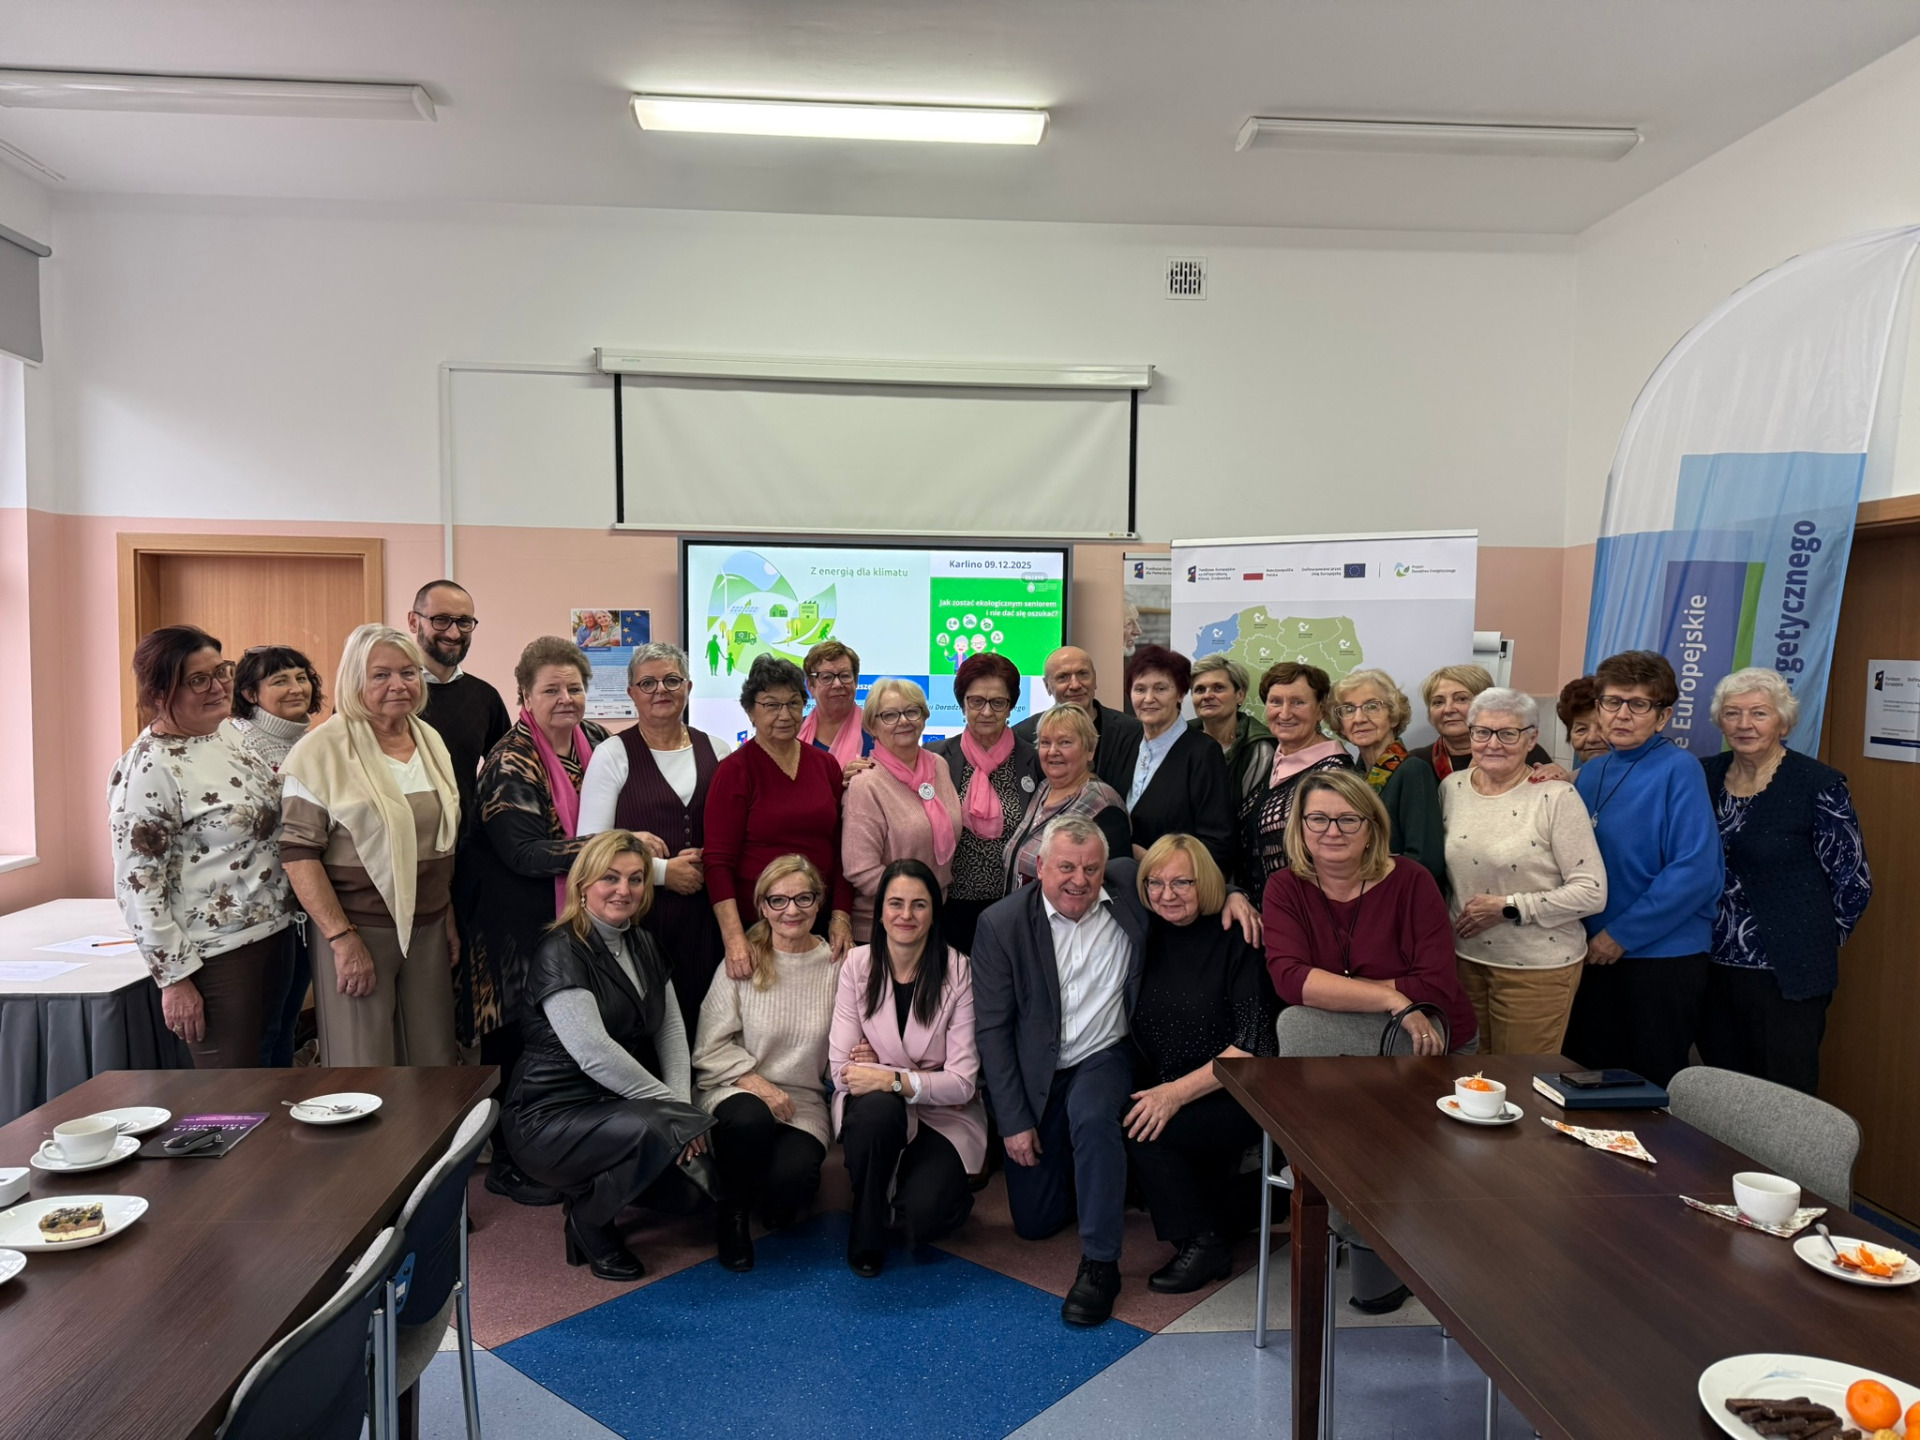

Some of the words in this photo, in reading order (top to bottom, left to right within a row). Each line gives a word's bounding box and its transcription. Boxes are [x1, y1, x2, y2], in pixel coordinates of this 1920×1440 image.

[949, 560, 982, 569] Karlino
[984, 560, 1032, 569] 09.12.2025
[810, 566, 817, 575] Z
[819, 567, 854, 578] energią
[856, 567, 871, 576] dla
[873, 567, 908, 577] klimatu
[939, 599, 951, 607] Jak
[952, 599, 974, 607] zostać
[975, 600, 1023, 608] ekologicznym
[1773, 520, 1822, 690] getycznego
[1016, 610, 1026, 618] się
[1672, 595, 1707, 730] Europejskie
